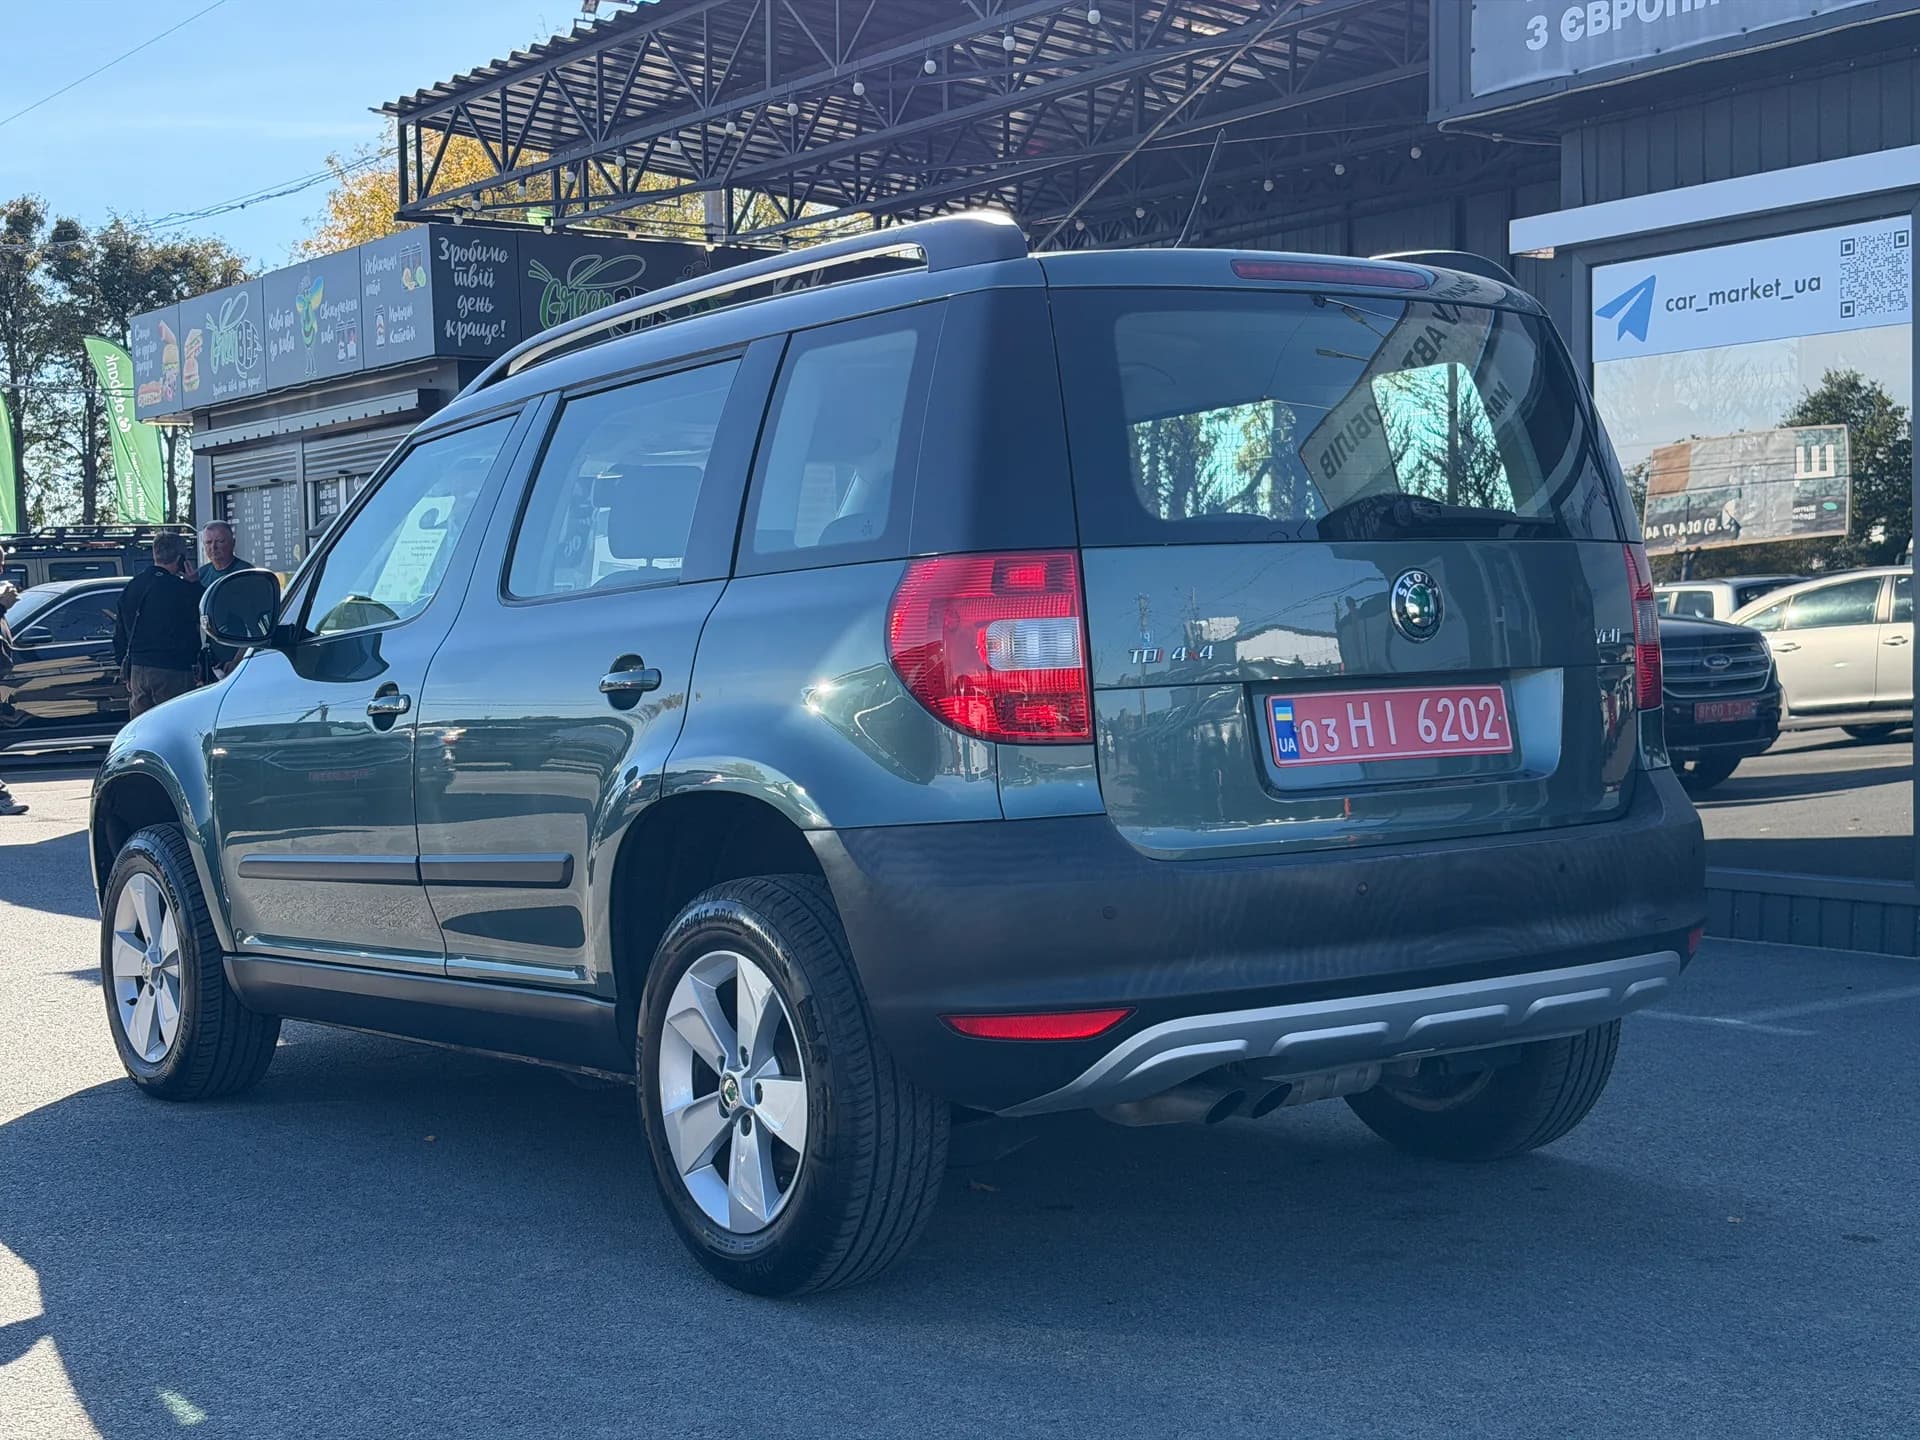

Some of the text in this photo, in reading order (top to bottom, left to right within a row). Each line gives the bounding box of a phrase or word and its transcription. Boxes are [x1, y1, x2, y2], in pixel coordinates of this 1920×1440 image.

[1526, 0, 1722, 50] З ЄВРО
[438, 237, 509, 269] Зробимо
[454, 263, 495, 288] твій
[457, 294, 494, 319] день
[1665, 276, 1822, 312] car_market_ua
[444, 319, 506, 347] краще!
[1128, 646, 1164, 664] TDI
[1301, 718, 1340, 753] 03
[1417, 696, 1500, 743] 6202
[1279, 737, 1297, 753] UA
